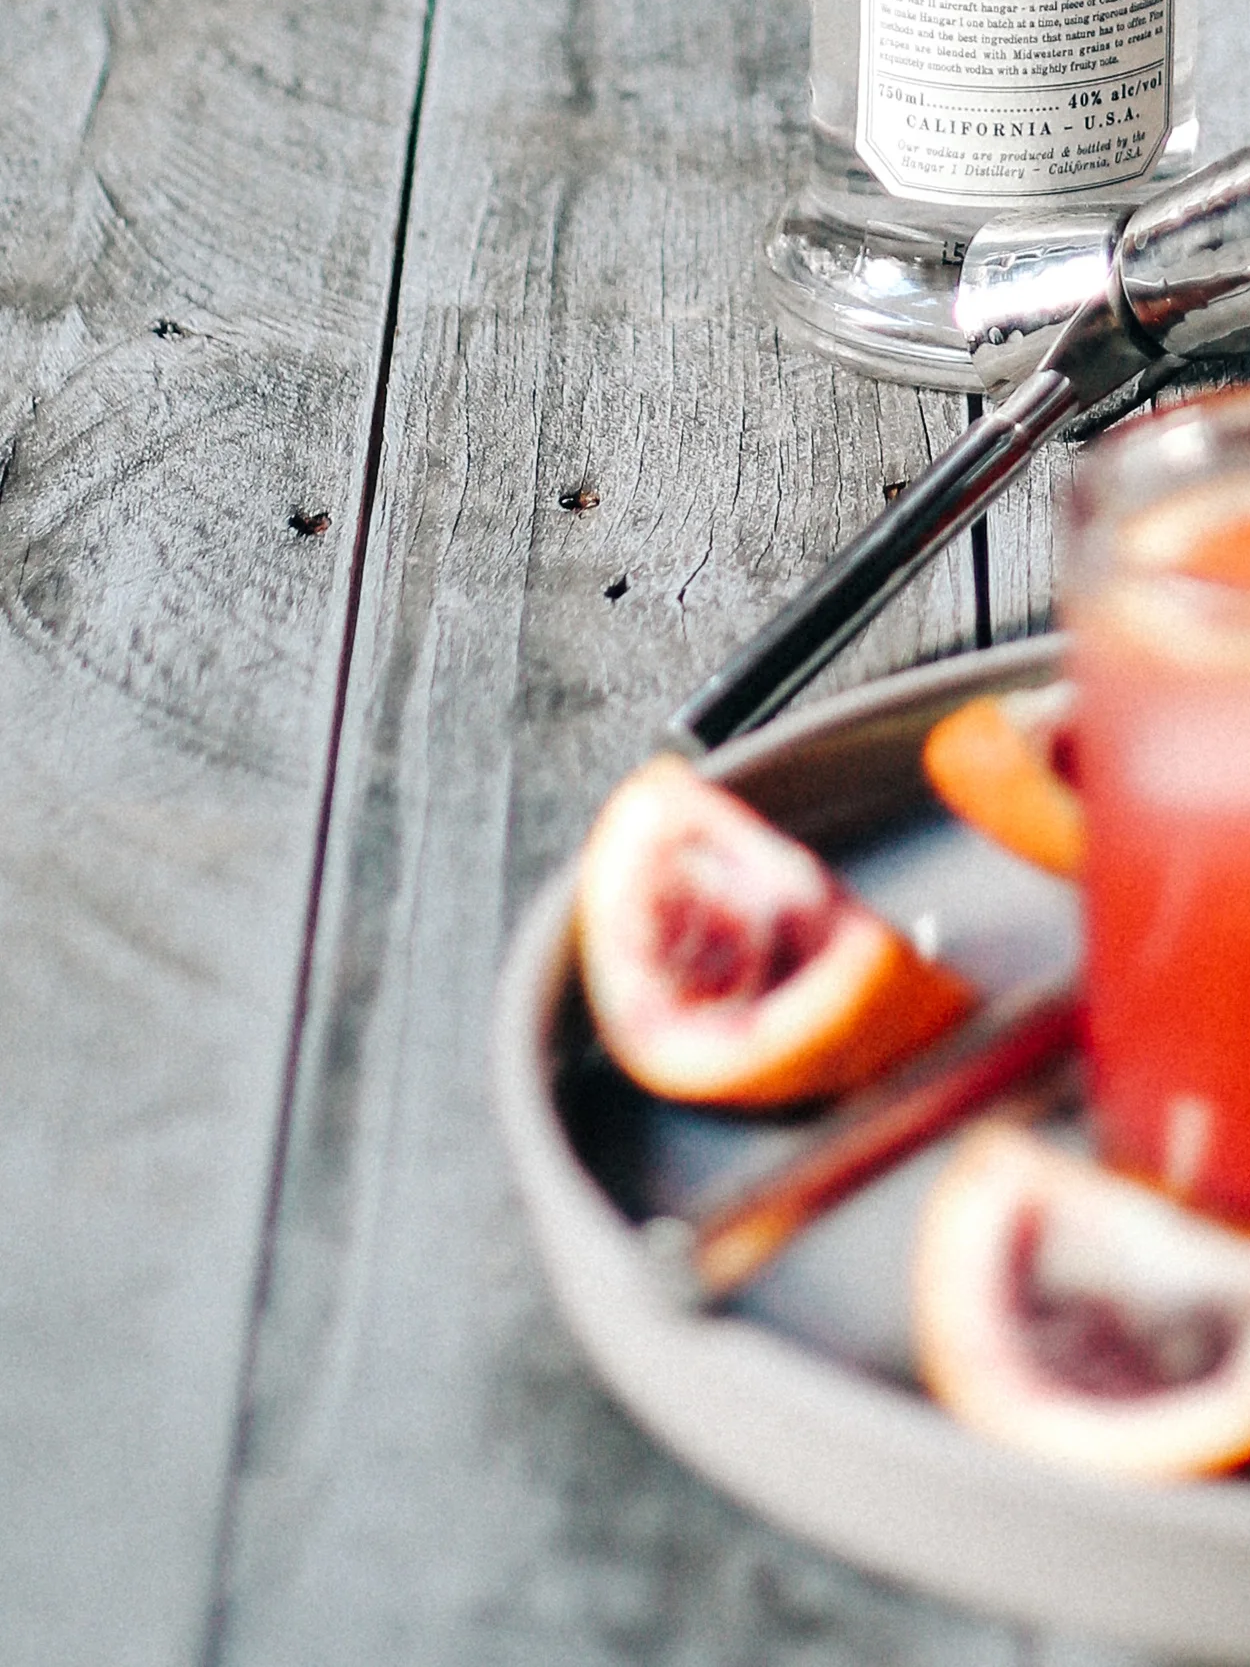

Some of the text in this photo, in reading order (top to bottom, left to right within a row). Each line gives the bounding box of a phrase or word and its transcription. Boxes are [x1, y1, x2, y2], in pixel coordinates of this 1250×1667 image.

[920, 12, 957, 27] Hangar
[966, 20, 984, 28] one
[987, 19, 1015, 29] batch
[1016, 19, 1027, 28] at
[1037, 18, 1062, 28] time,
[1064, 12, 1090, 26] using
[1092, 6, 1128, 22] rigorous
[939, 0, 978, 12] aircraft
[981, 2, 1018, 15] hangar
[1039, 1, 1058, 12] real
[914, 44, 932, 54] are
[937, 46, 977, 59] blended
[983, 49, 1007, 60] with
[1013, 49, 1074, 60] Midwestern
[1079, 41, 1111, 57] grains
[1114, 37, 1124, 48] to
[1127, 30, 1152, 45] create
[917, 30, 935, 39] and
[938, 31, 954, 41] the
[957, 33, 978, 43] best
[981, 34, 1038, 47] ingredients
[1042, 32, 1062, 43] that
[1065, 29, 1096, 41] nature
[1098, 25, 1114, 35] has
[1116, 23, 1125, 32] to
[928, 61, 962, 74] smooth
[965, 64, 994, 74] vodka
[996, 65, 1019, 75] with
[1031, 63, 1067, 77] slightly
[1070, 60, 1097, 73] fruity
[1068, 90, 1102, 109] 40%
[1111, 71, 1162, 101] alc/vol
[906, 114, 1052, 137] CALIFORNIA
[1085, 106, 1140, 130] U.S.A.
[897, 130, 1146, 163] Our vodkas are produced & bottled by the
[901, 155, 944, 173] Hangar
[965, 164, 1025, 179] Distillery
[1048, 157, 1110, 175] California,
